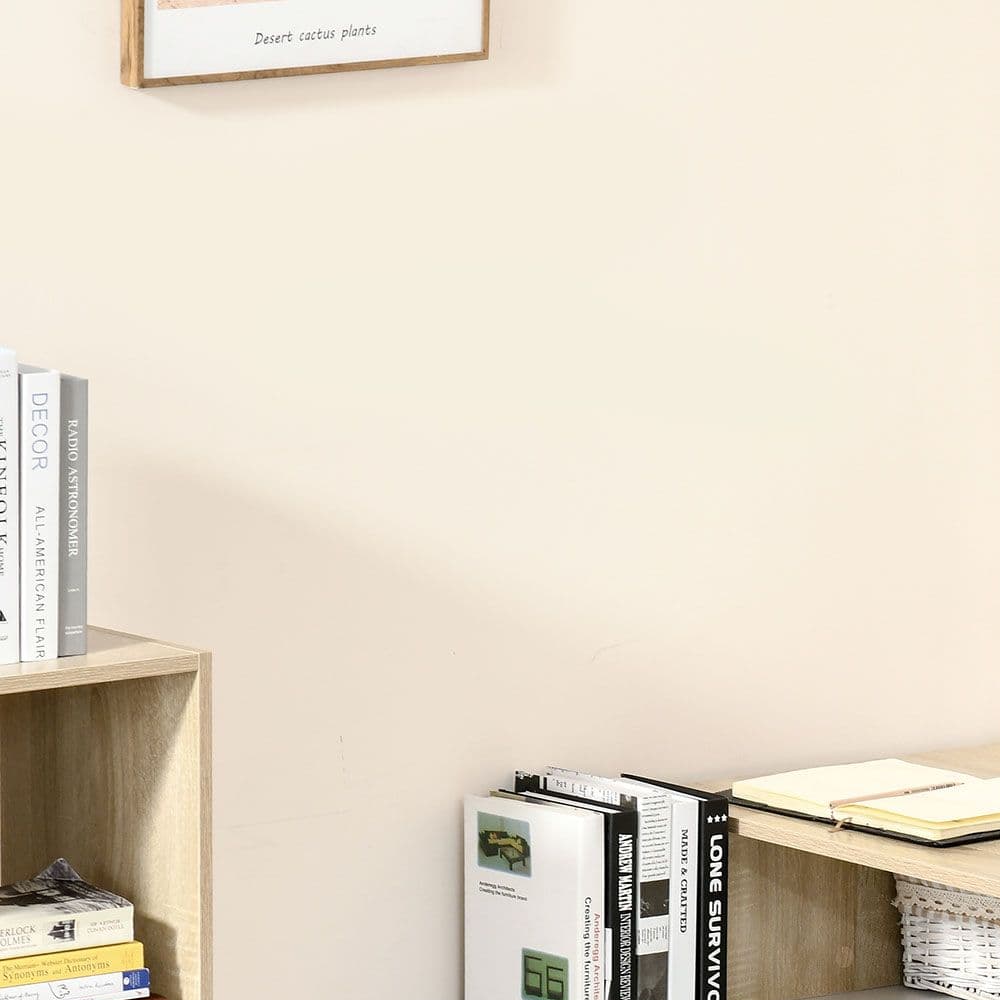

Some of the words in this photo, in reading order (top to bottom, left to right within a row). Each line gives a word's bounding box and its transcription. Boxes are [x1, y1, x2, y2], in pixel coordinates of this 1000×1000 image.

[254, 31, 293, 45] Desert
[299, 28, 336, 41] cactus
[340, 24, 377, 41] plants
[31, 392, 48, 470] DECOR
[67, 420, 79, 461] RADIO
[67, 466, 79, 557] ASTRONOMER
[35, 505, 46, 612] ALL-AMERICAN
[35, 618, 46, 658] FLAIR
[618, 833, 633, 873] ANDREW
[681, 829, 689, 865] MADE
[709, 834, 724, 893] LONE
[680, 867, 688, 875] &
[618, 874, 633, 911] MARTIN
[680, 879, 688, 933] CRAFTED
[583, 897, 592, 939] Creating
[592, 913, 601, 962] Anderegg
[584, 940, 592, 957] the
[2, 969, 49, 983] Synonyms
[65, 960, 111, 973] Antonyms
